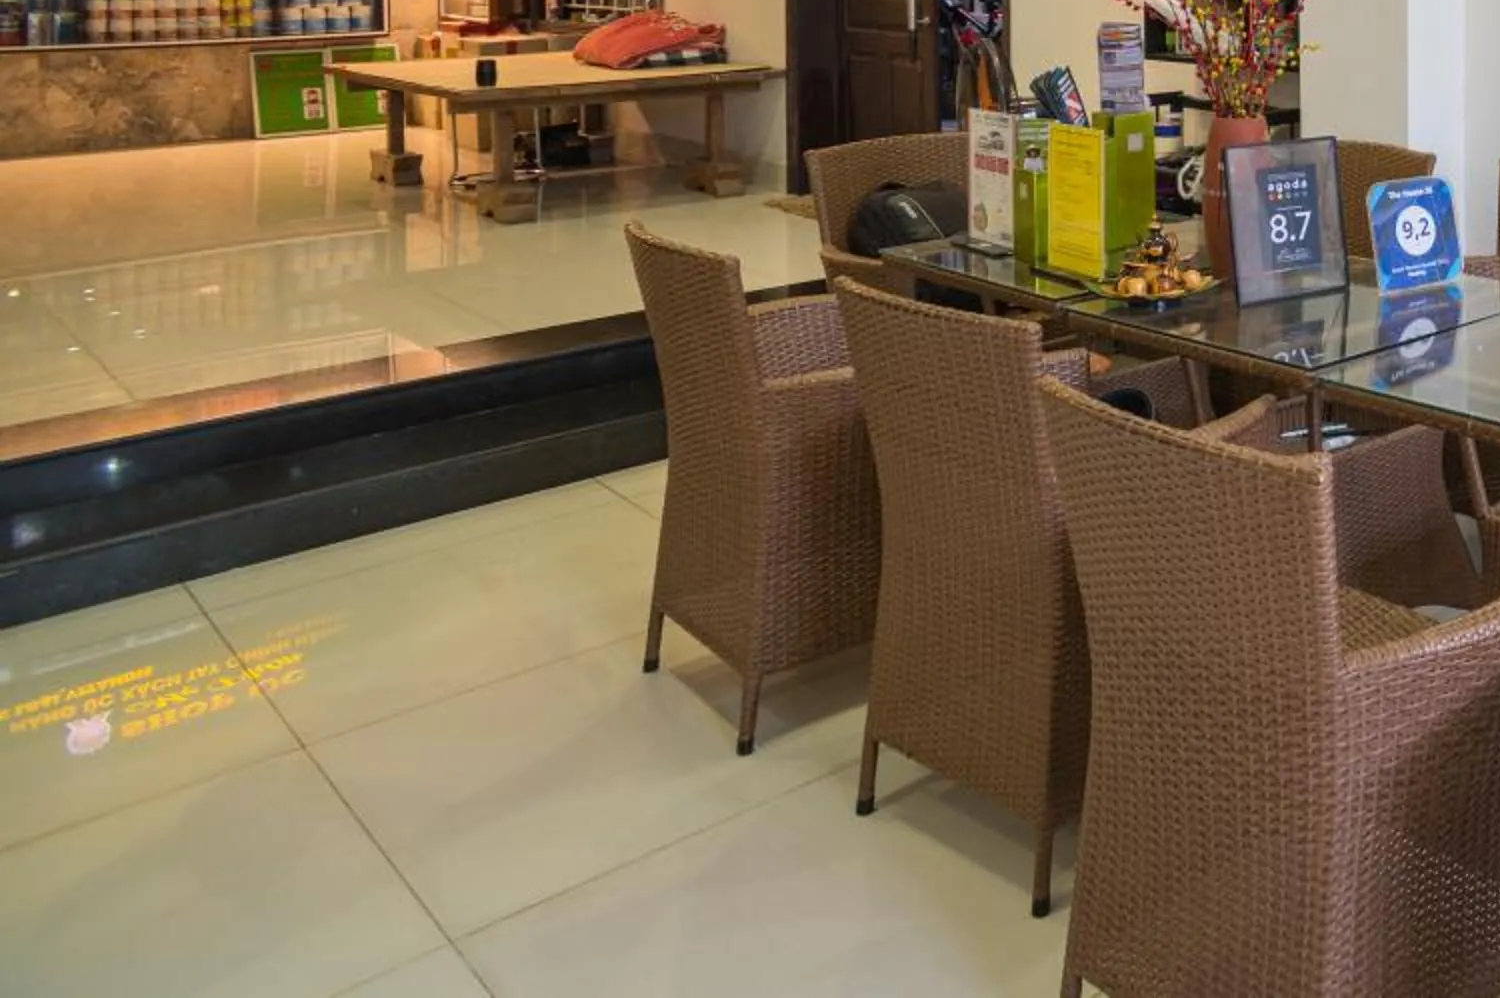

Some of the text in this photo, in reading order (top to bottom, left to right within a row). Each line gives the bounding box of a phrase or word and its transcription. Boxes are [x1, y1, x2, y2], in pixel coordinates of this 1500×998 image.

[1267, 177, 1308, 193] agoda
[1269, 210, 1312, 244] 8.7
[1402, 217, 1431, 242] 9,2
